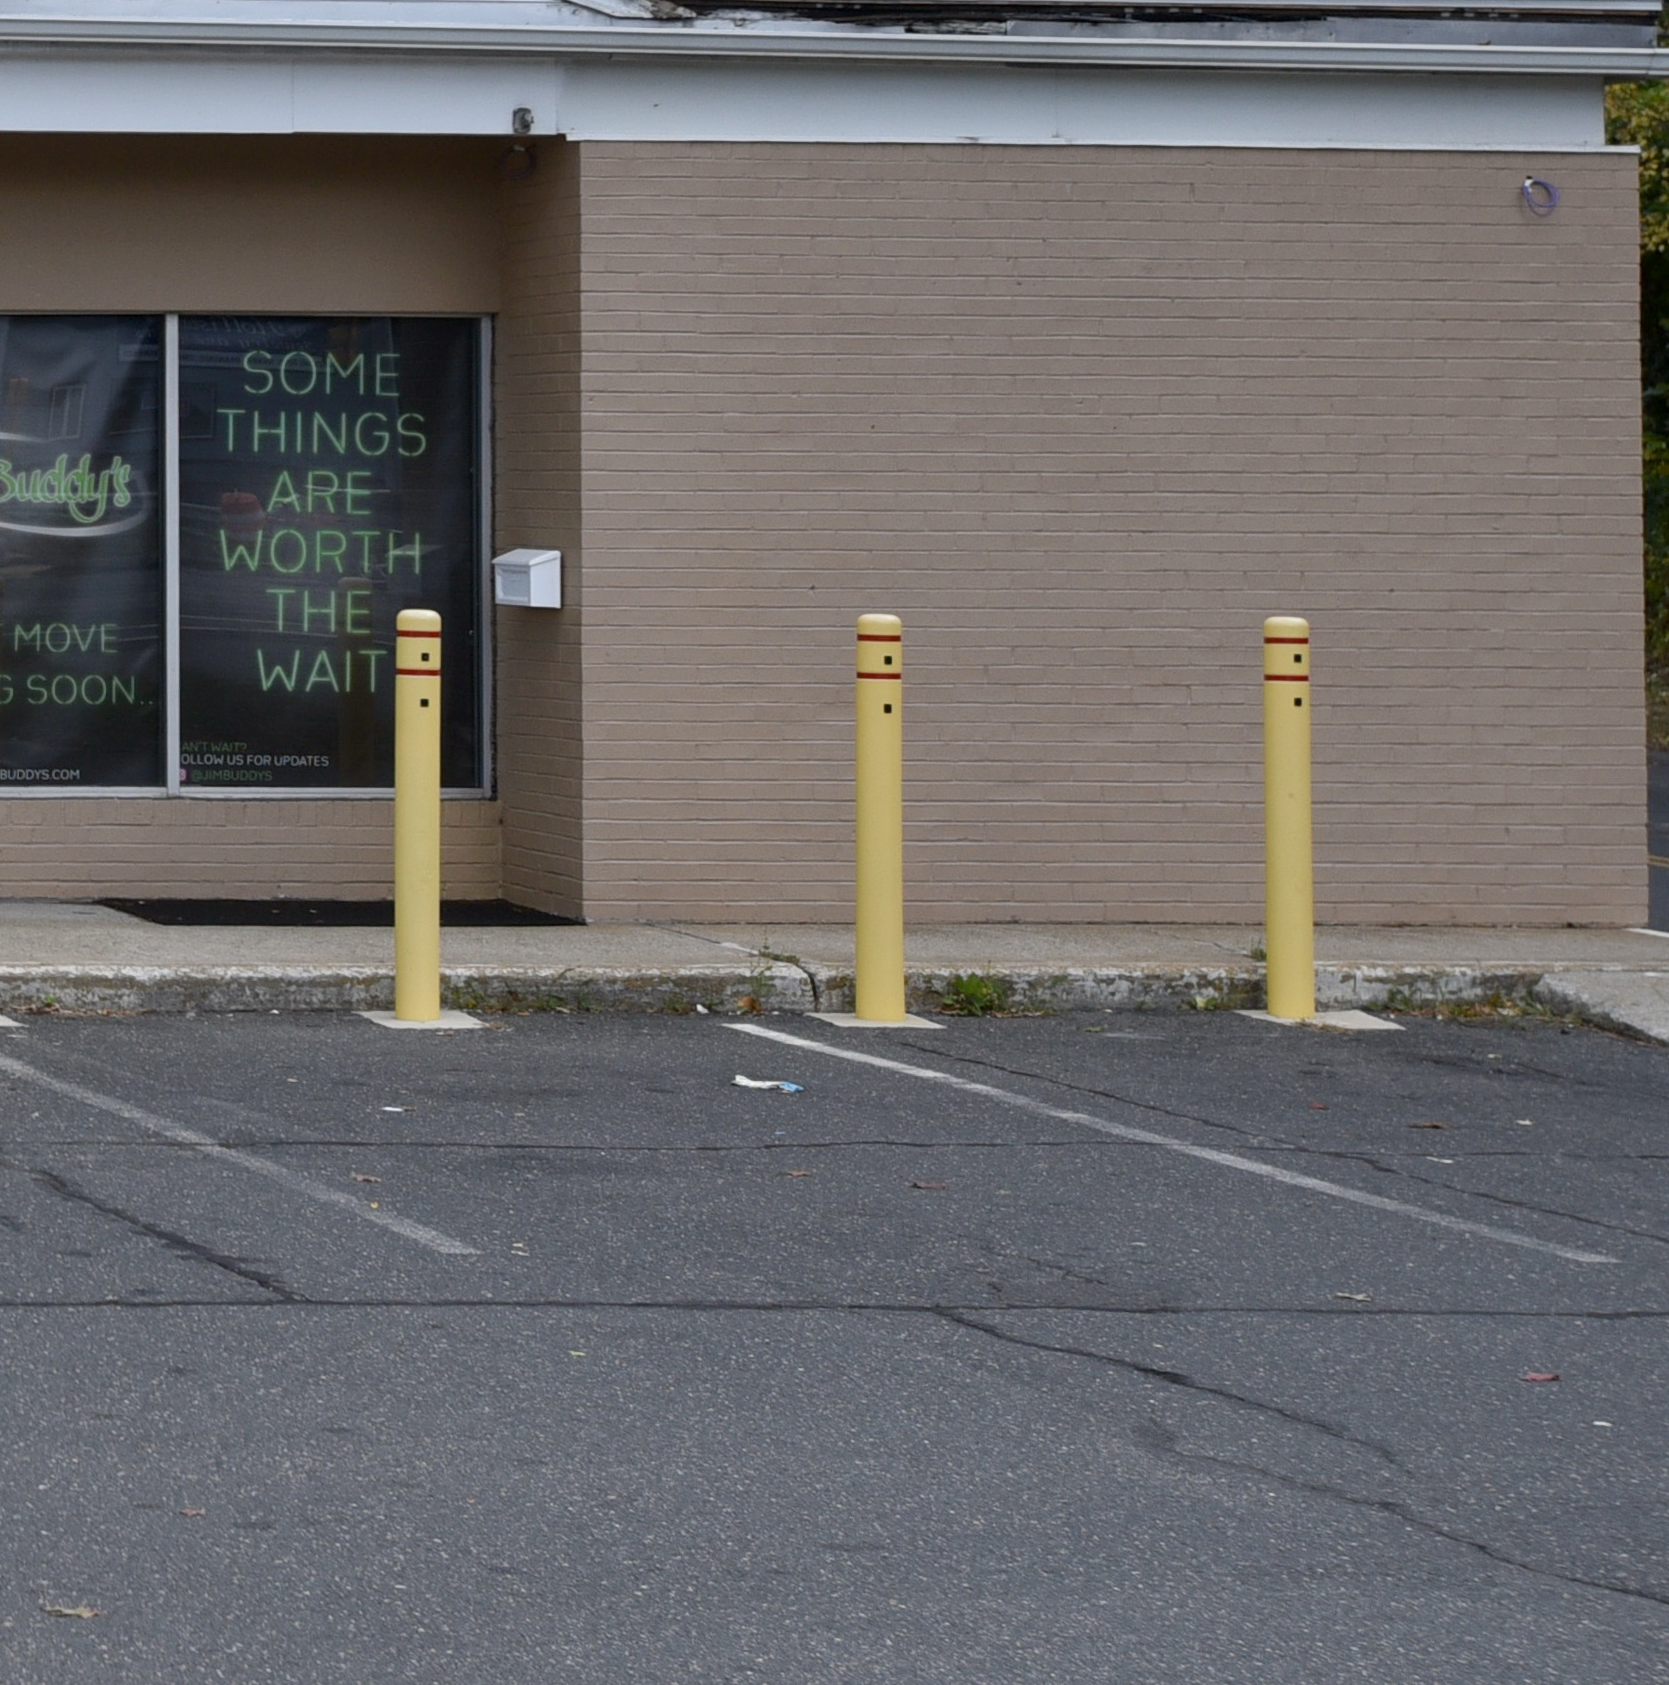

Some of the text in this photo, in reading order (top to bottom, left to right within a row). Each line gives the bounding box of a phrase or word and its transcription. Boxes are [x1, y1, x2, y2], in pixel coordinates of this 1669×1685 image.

[243, 351, 401, 397] SOME
[217, 408, 427, 457] THINGS
[266, 470, 372, 515] ARE
[220, 529, 421, 574] WORTH
[266, 588, 371, 635] THE
[14, 623, 119, 653] MOVE
[257, 649, 388, 693] WAIT
[181, 742, 247, 752] AN'T WAIT?
[181, 753, 329, 767] OLLOW US FOR UPDATES
[191, 769, 272, 782] @JIMBUDDYS
